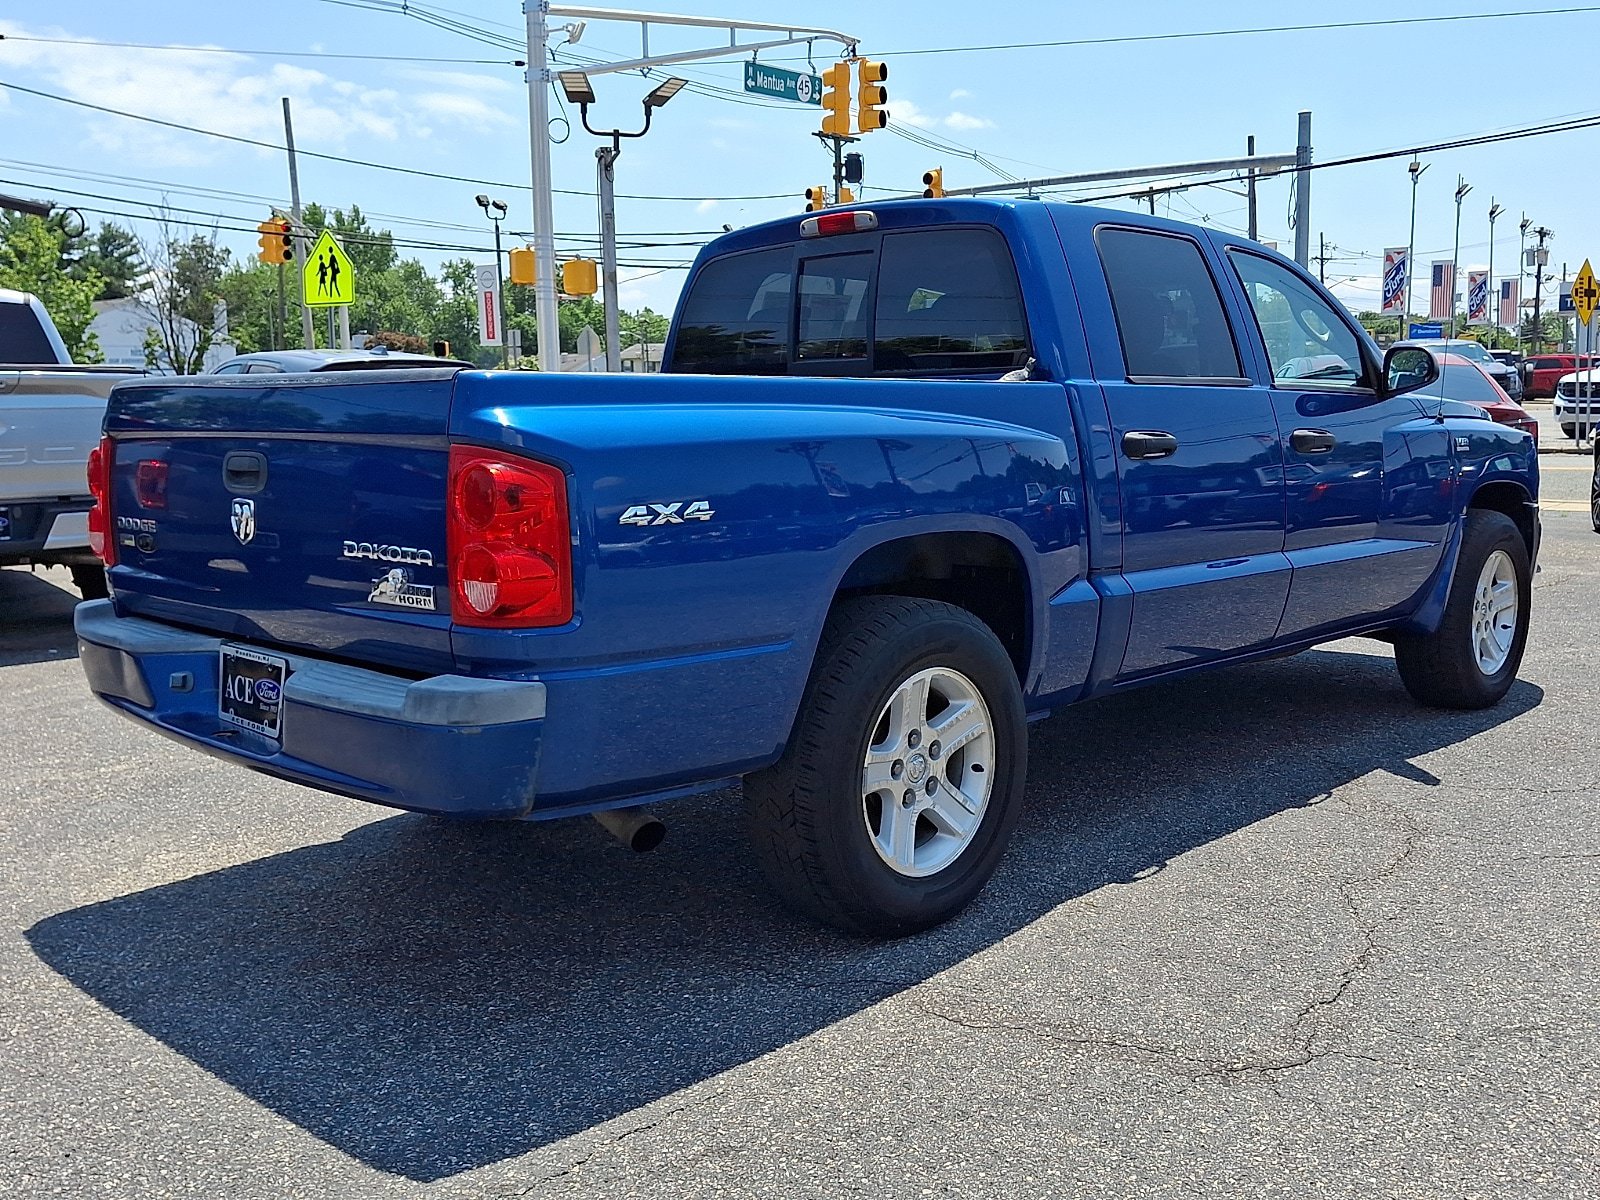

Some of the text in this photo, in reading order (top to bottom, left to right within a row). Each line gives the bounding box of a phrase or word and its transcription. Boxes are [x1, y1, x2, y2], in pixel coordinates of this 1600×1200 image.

[756, 70, 810, 95] Mantua Ave 45
[814, 80, 819, 91] S
[1383, 264, 1405, 297] Ford
[1469, 283, 1486, 310] Ford
[117, 516, 157, 533] DODGE
[343, 540, 433, 567] DAKOTA
[398, 594, 432, 608] HORN
[407, 586, 427, 596] BIG
[225, 673, 254, 704] ACE
[259, 681, 278, 700] Ford
